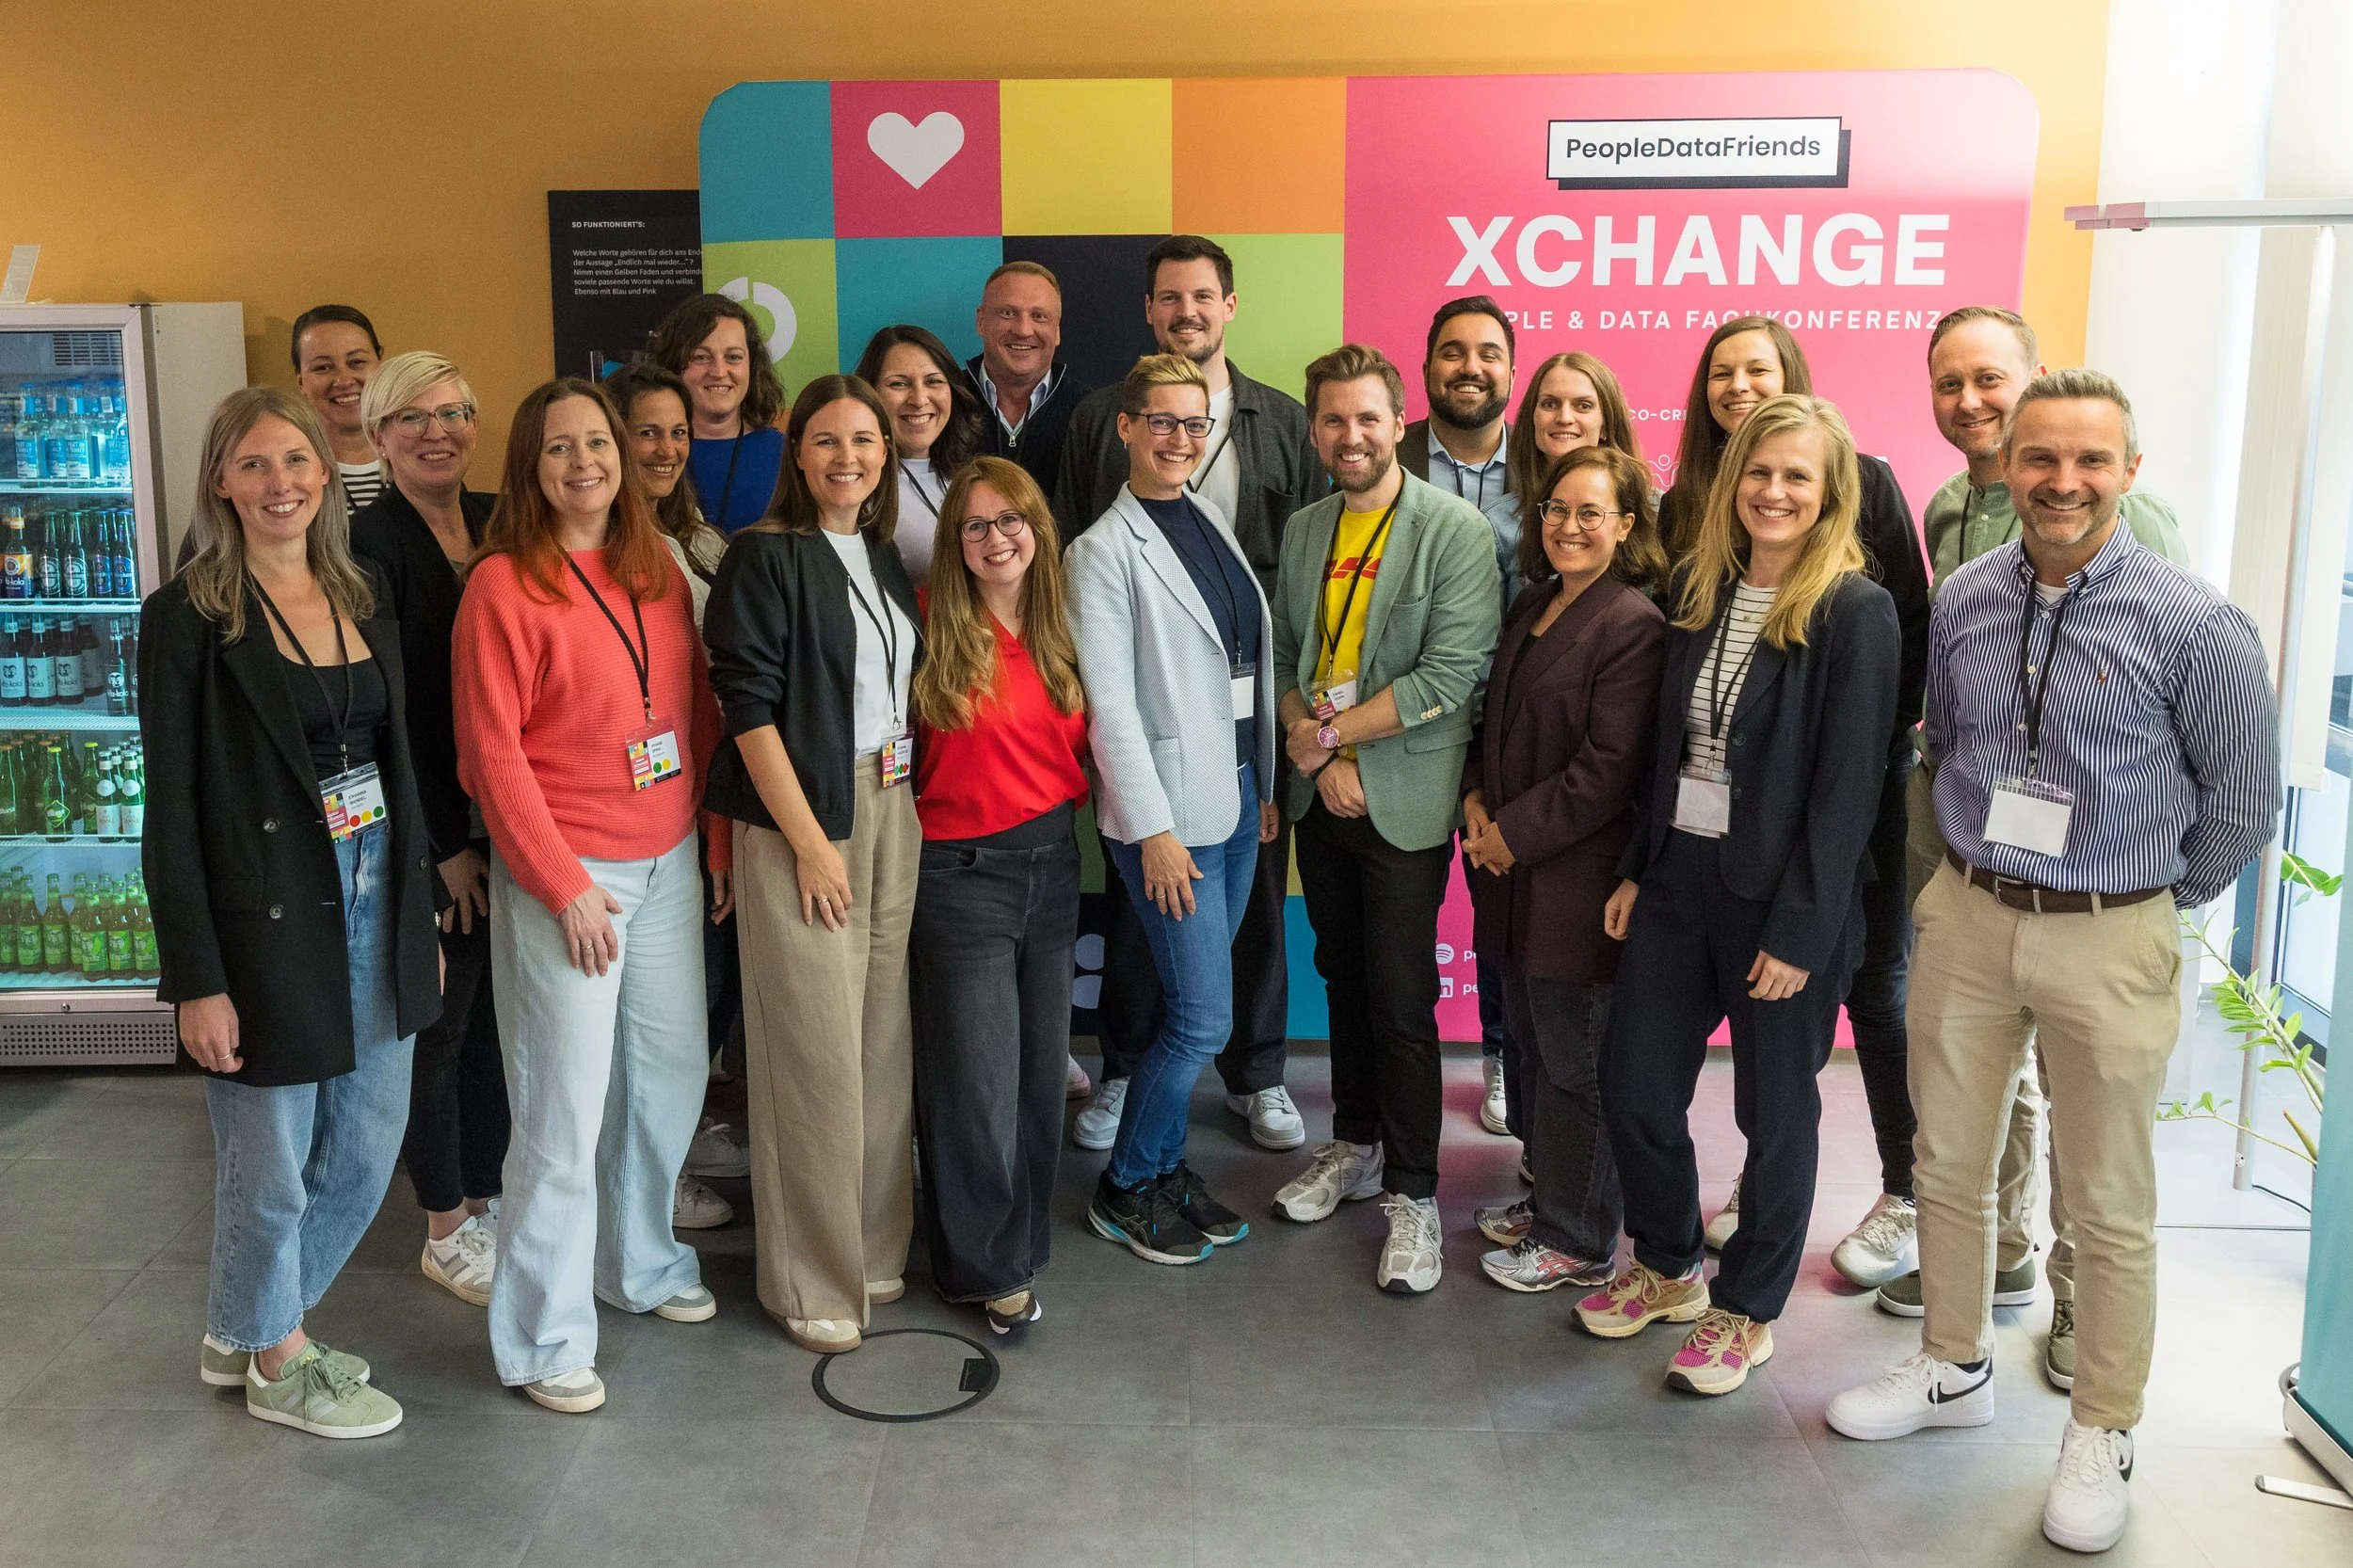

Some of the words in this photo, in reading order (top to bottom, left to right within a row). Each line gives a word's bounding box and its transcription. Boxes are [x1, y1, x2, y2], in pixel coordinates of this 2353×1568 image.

[1565, 136, 1821, 165] PeopleDataFriends
[620, 248, 647, 258] gehören
[1445, 213, 1951, 288] XCHANGE
[585, 259, 613, 267] Aussage
[1567, 311, 1584, 329] &
[1599, 311, 1672, 329] DATA
[1629, 408, 1688, 422] CO-CR
